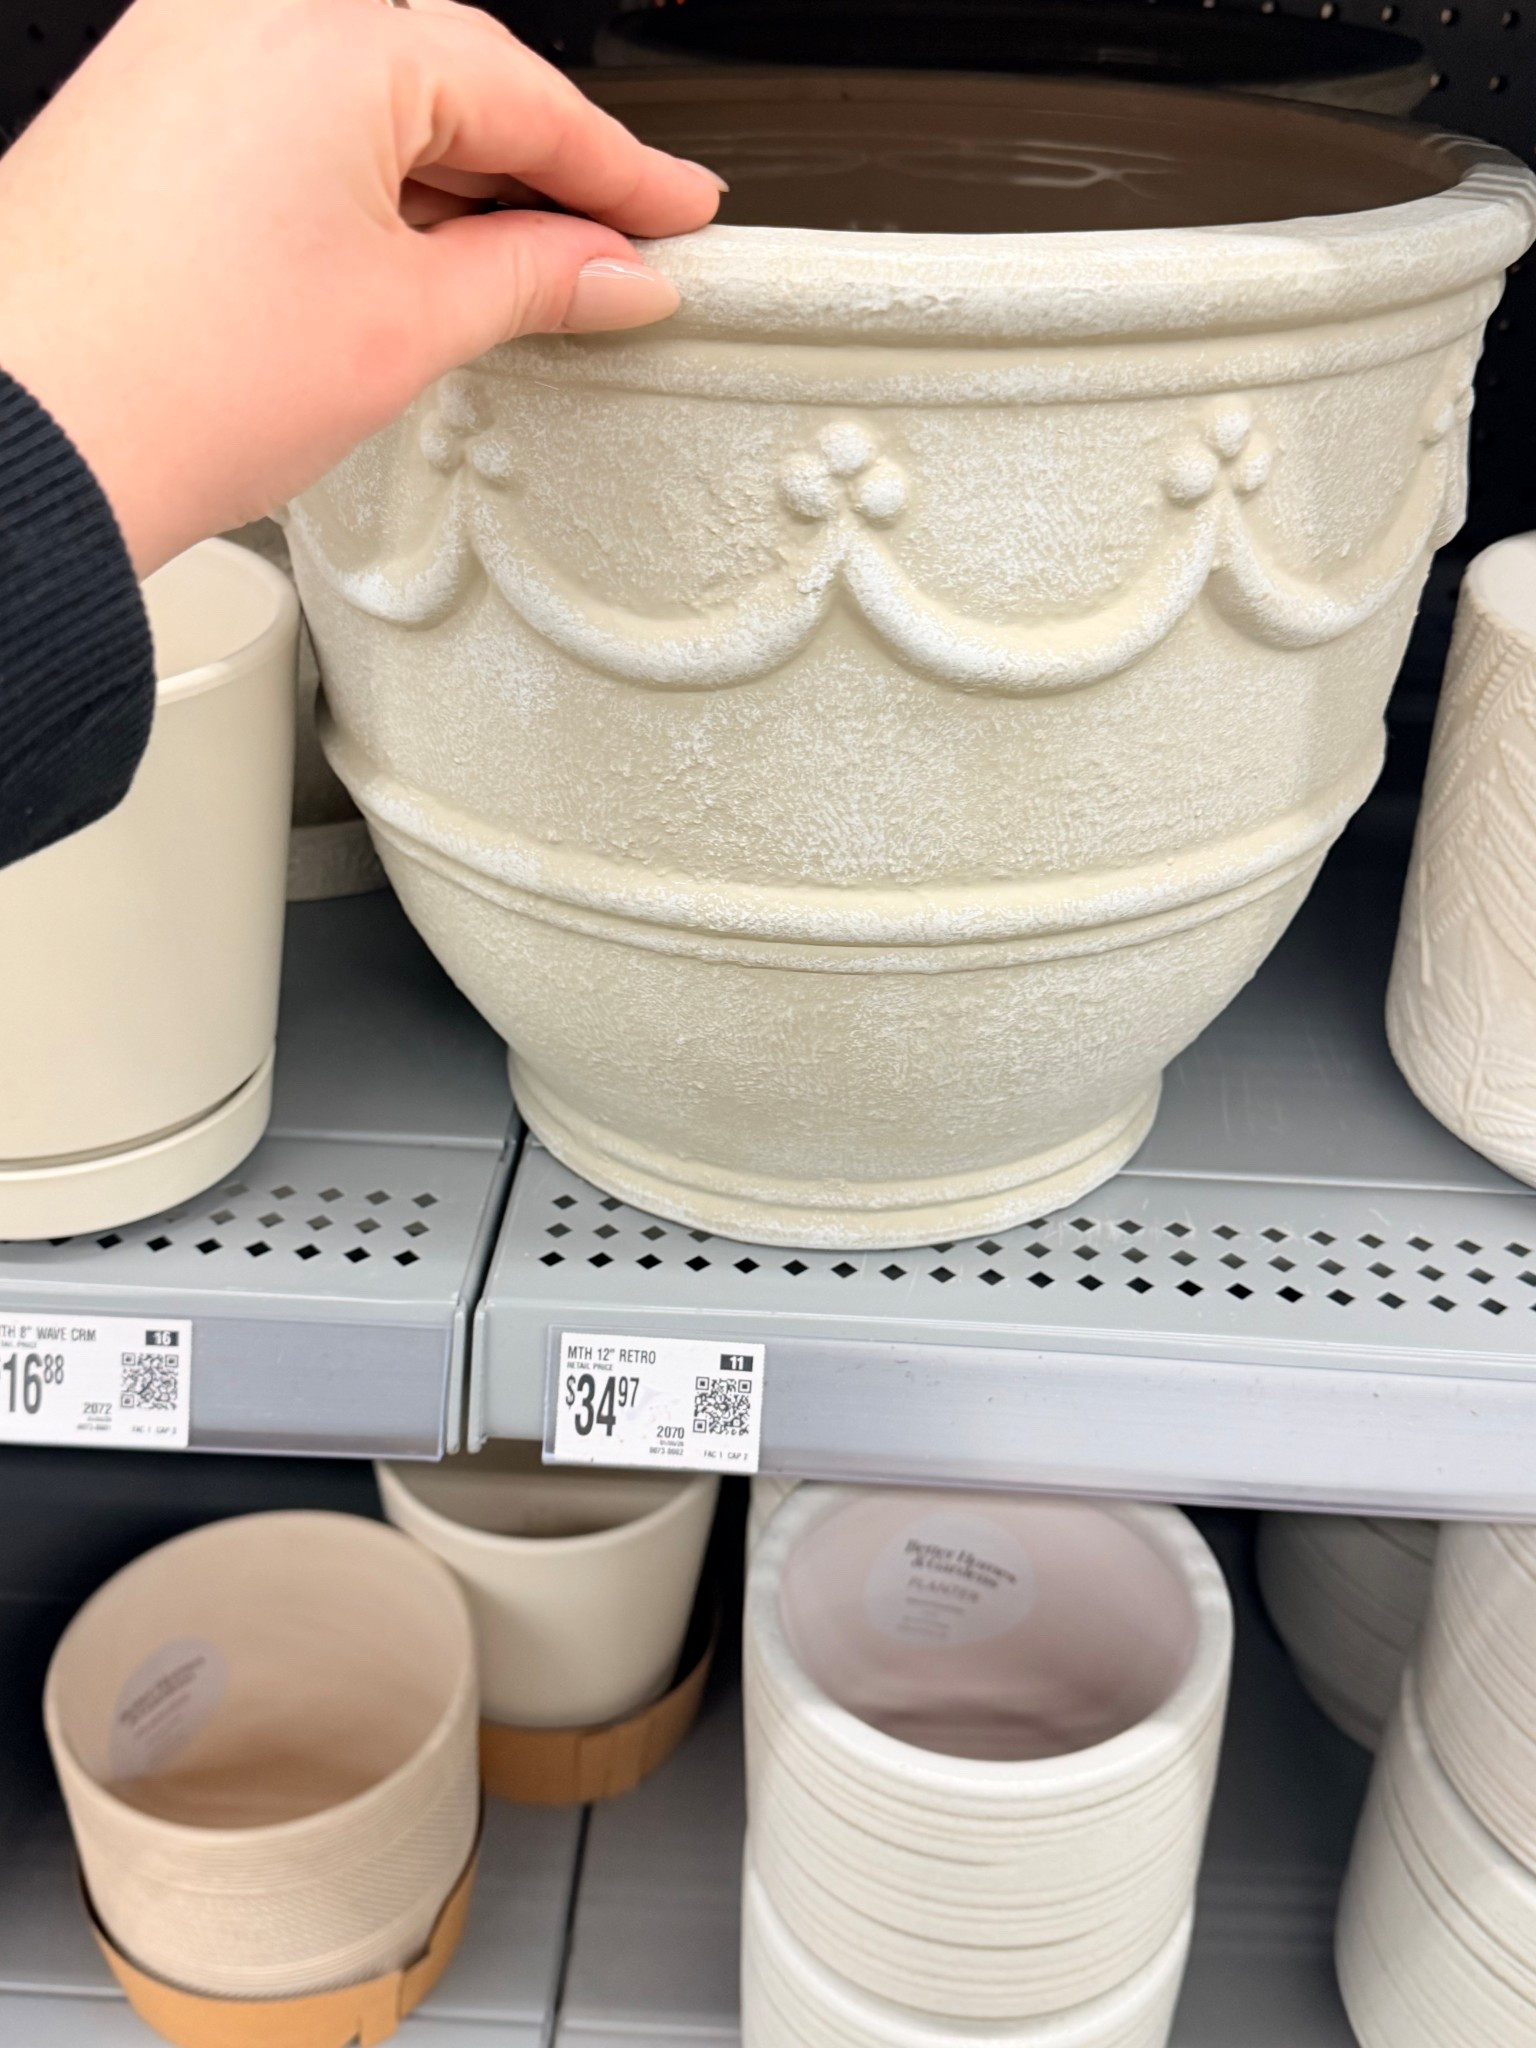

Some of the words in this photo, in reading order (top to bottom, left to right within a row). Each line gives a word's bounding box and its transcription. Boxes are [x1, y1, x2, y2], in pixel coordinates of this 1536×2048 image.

[0, 1325, 15, 1338] TH
[37, 1328, 66, 1340] WAVE
[71, 1329, 96, 1342] CRM
[154, 1332, 171, 1345] 16
[568, 1346, 592, 1361] MTH
[619, 1350, 656, 1365] RETRO
[729, 1356, 744, 1370] 11
[83, 1402, 112, 1414] 2072
[657, 1426, 685, 1439] 2070
[908, 1576, 980, 1603] PLANTER
